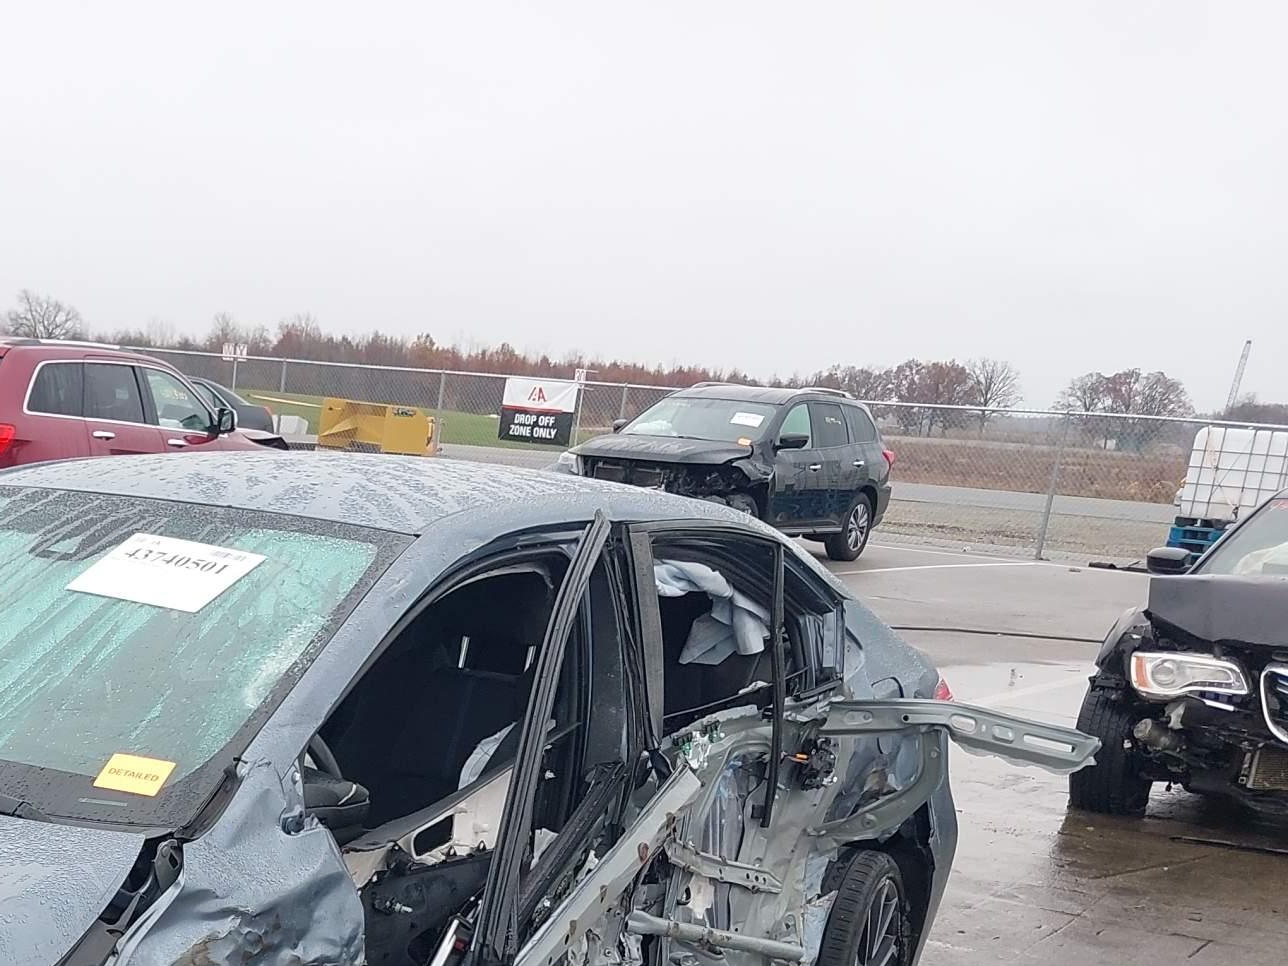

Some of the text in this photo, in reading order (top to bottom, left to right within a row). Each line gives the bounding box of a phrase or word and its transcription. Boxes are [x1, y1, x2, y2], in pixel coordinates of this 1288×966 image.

[514, 413, 555, 427] DROP OFF
[509, 425, 557, 439] ZONE ONLY
[124, 547, 231, 575] 43740501
[107, 767, 160, 782] DETAILED
